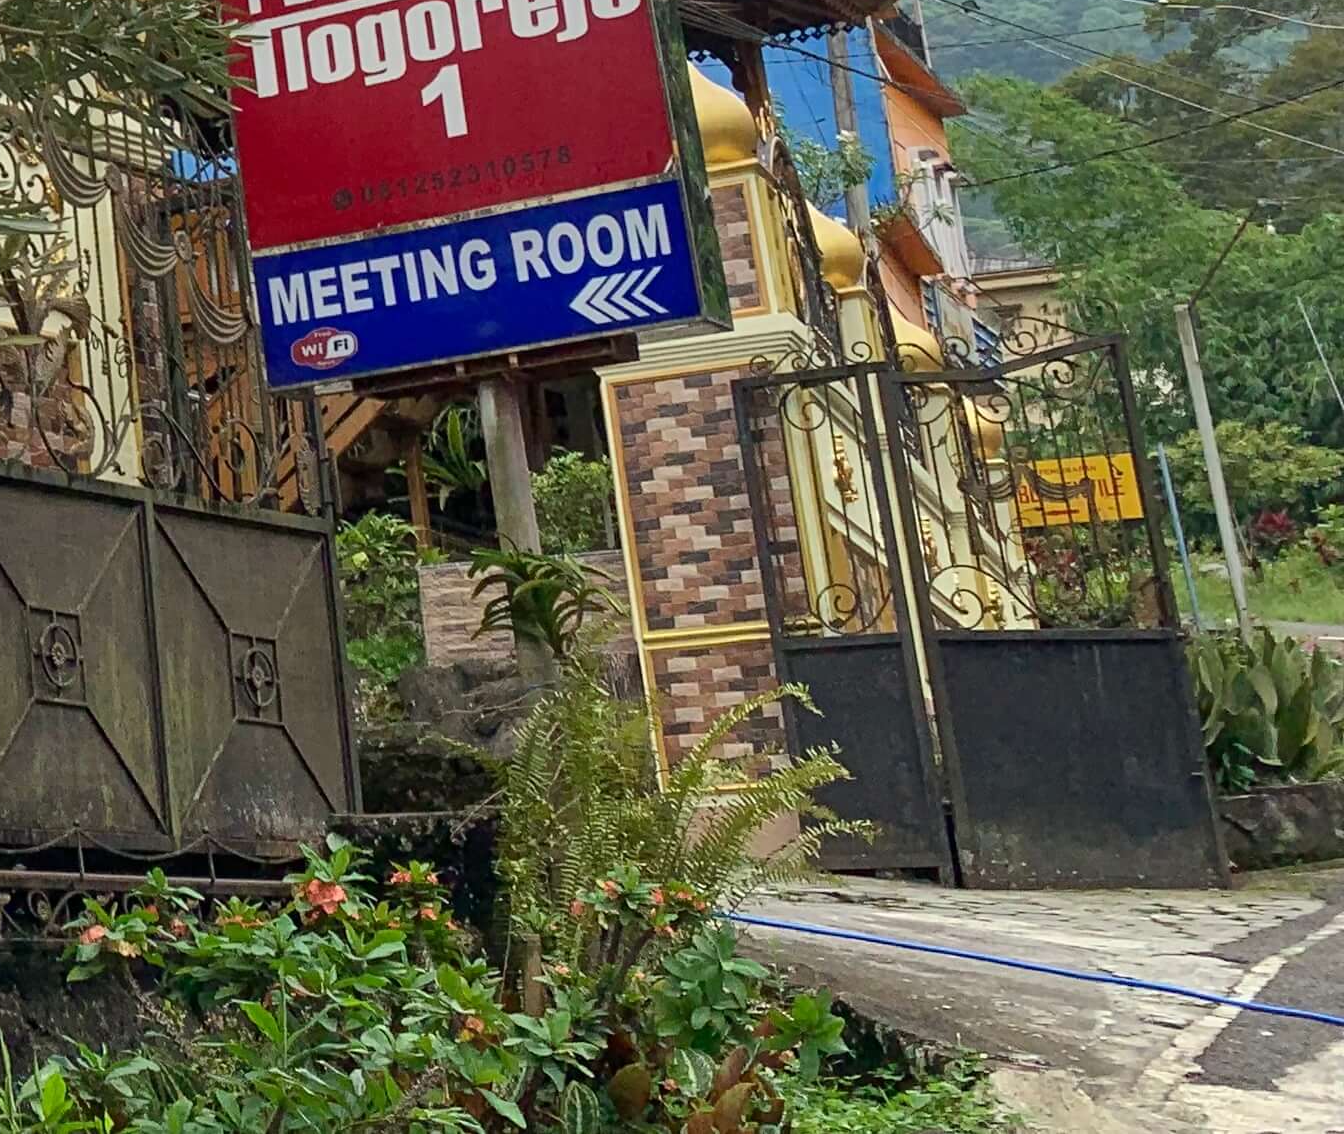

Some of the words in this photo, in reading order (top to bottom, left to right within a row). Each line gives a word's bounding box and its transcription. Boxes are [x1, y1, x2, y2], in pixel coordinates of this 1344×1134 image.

[420, 63, 469, 138] 1
[267, 238, 498, 326] MEETING
[511, 203, 672, 282] ROOM
